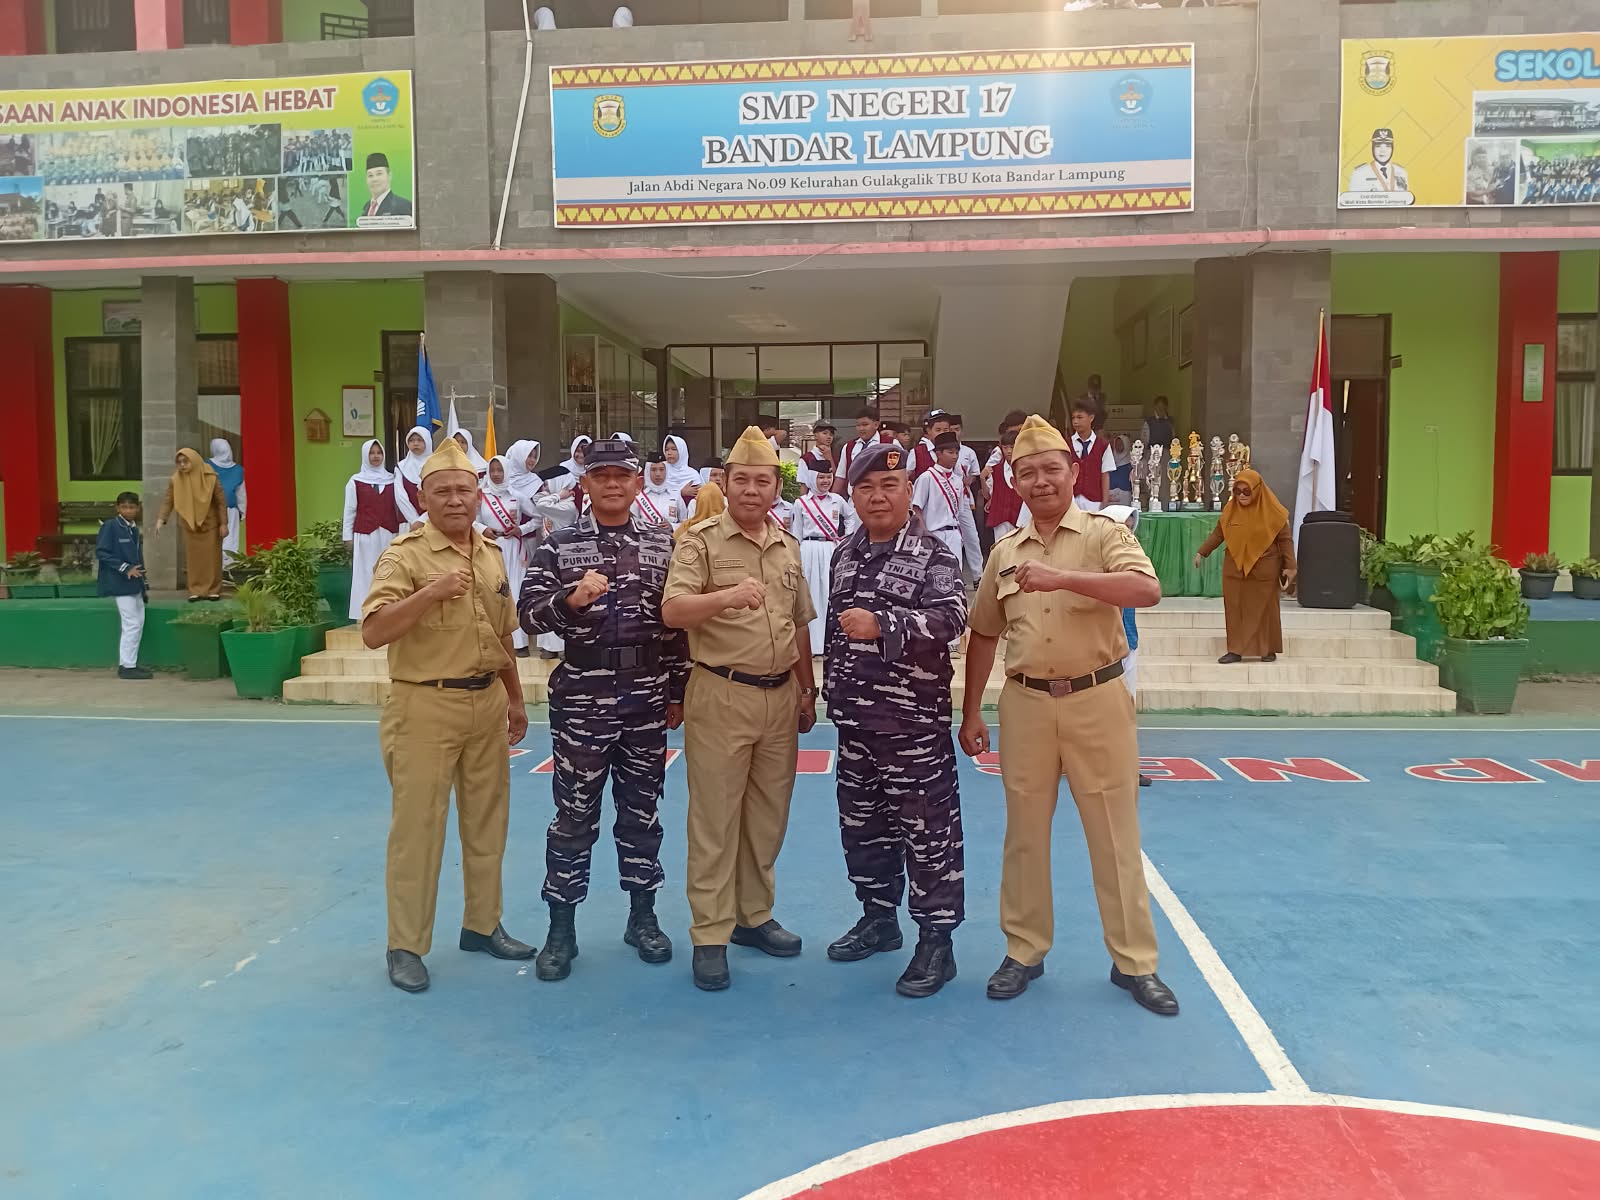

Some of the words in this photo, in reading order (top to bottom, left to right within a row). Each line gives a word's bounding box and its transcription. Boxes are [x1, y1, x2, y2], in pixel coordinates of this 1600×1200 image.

[60, 99, 127, 122] ANAK
[133, 93, 259, 119] INDONESIA
[264, 88, 337, 112] HEBAT
[741, 93, 816, 121] SMP
[830, 88, 967, 118] NEGERI
[983, 86, 1013, 113] 17
[705, 135, 854, 165] BANDAR
[867, 129, 1050, 160] LAMPUNG
[627, 180, 661, 195] Jalan
[664, 179, 694, 192] Abdi
[698, 179, 743, 193] Negara
[747, 178, 787, 190] No.09
[790, 176, 858, 189] Kelurahan
[861, 173, 934, 189] Gulakgalik
[936, 173, 968, 185] TBU
[972, 172, 1004, 184] Kota
[1007, 170, 1055, 183] Bandar
[1059, 169, 1126, 183] Lampung
[562, 555, 600, 567] PURWO
[641, 555, 658, 565] TNI
[888, 563, 904, 574] TNI
[905, 568, 921, 578] AL
